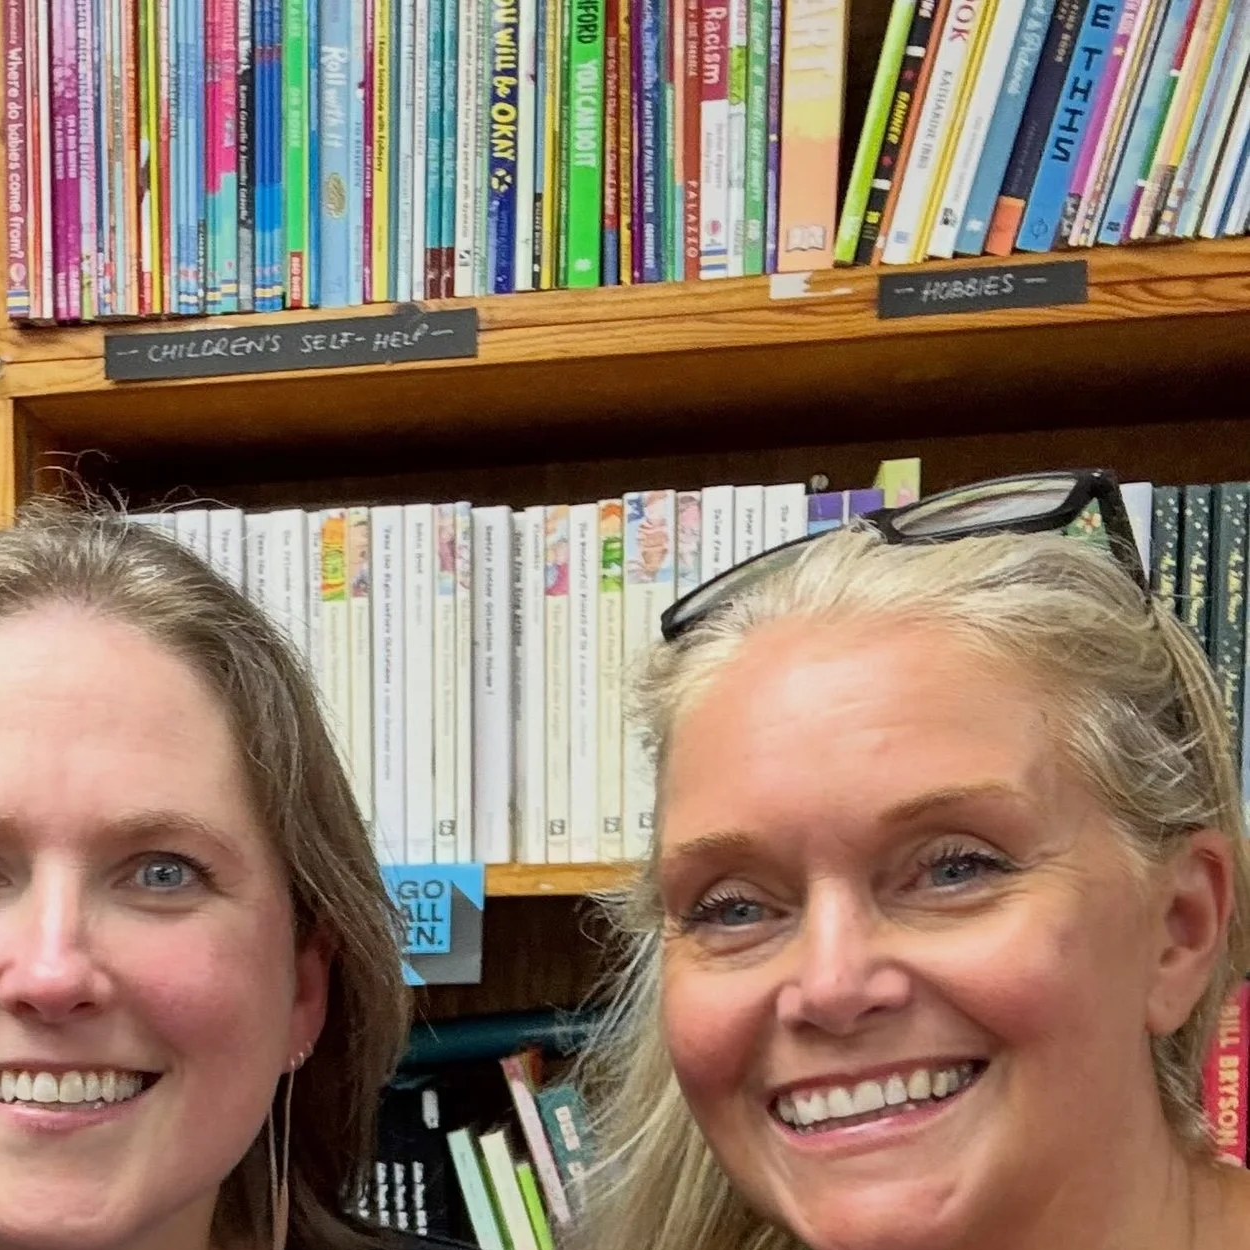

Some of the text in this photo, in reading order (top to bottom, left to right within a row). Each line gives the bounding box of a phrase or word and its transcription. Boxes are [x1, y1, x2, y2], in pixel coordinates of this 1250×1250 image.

[950, 0, 976, 42] OK
[378, 41, 386, 65] Know
[703, 7, 728, 85] Racism
[320, 46, 350, 148] Roll with It
[378, 69, 386, 111] Someone
[490, 102, 517, 162] OKAY
[574, 60, 598, 168] YOU CAN DO IT
[644, 100, 654, 147] MATTHEW
[8, 47, 23, 258] Where do babies come from?
[375, 135, 386, 173] Epilepsy
[687, 180, 698, 258] PALAZZO
[922, 273, 1015, 303] HOBBIES
[147, 335, 280, 363] CHILDREN'S
[397, 879, 444, 900] GO
[1216, 1003, 1242, 1147] BILL BRYSON
